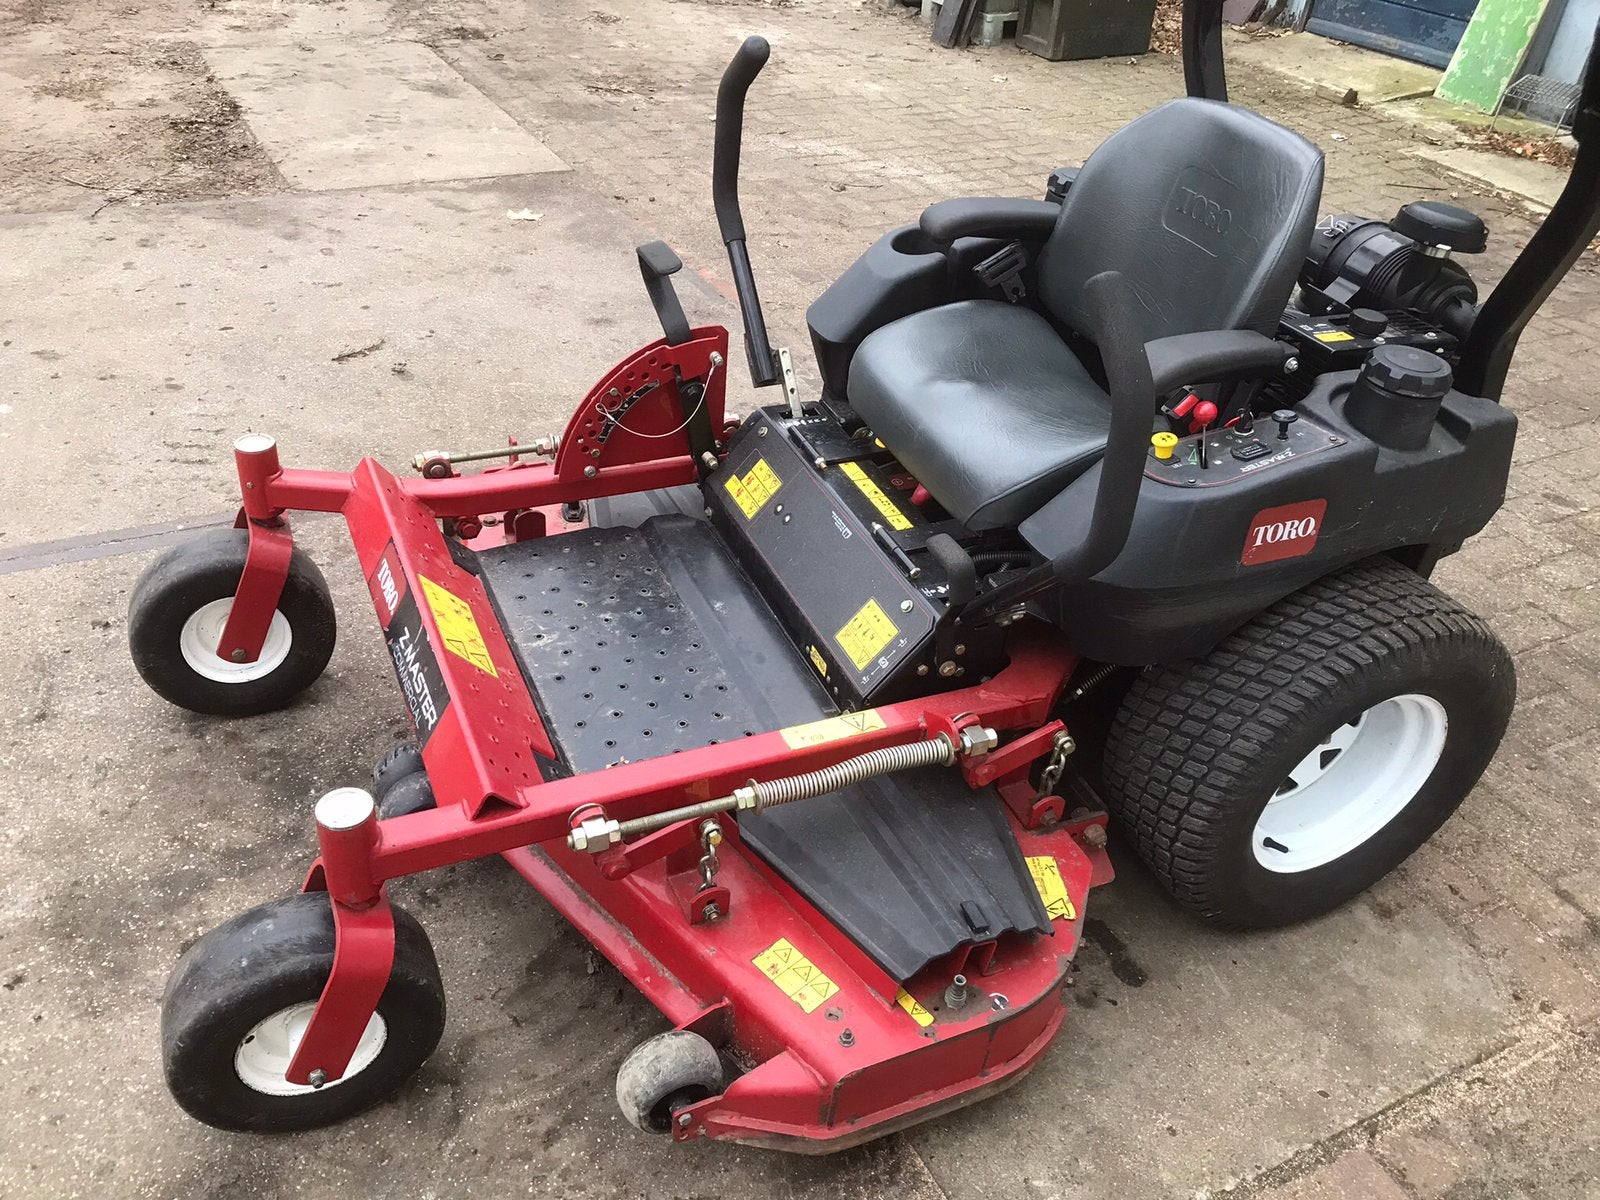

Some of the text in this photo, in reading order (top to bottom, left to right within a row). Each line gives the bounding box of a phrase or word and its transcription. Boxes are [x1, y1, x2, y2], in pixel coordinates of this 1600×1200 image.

[1176, 185, 1232, 235] TORO
[1252, 516, 1316, 548] TORO
[376, 557, 399, 613] TORO
[391, 642, 421, 729] COMMERCIAL
[404, 647, 438, 731] MASTER
